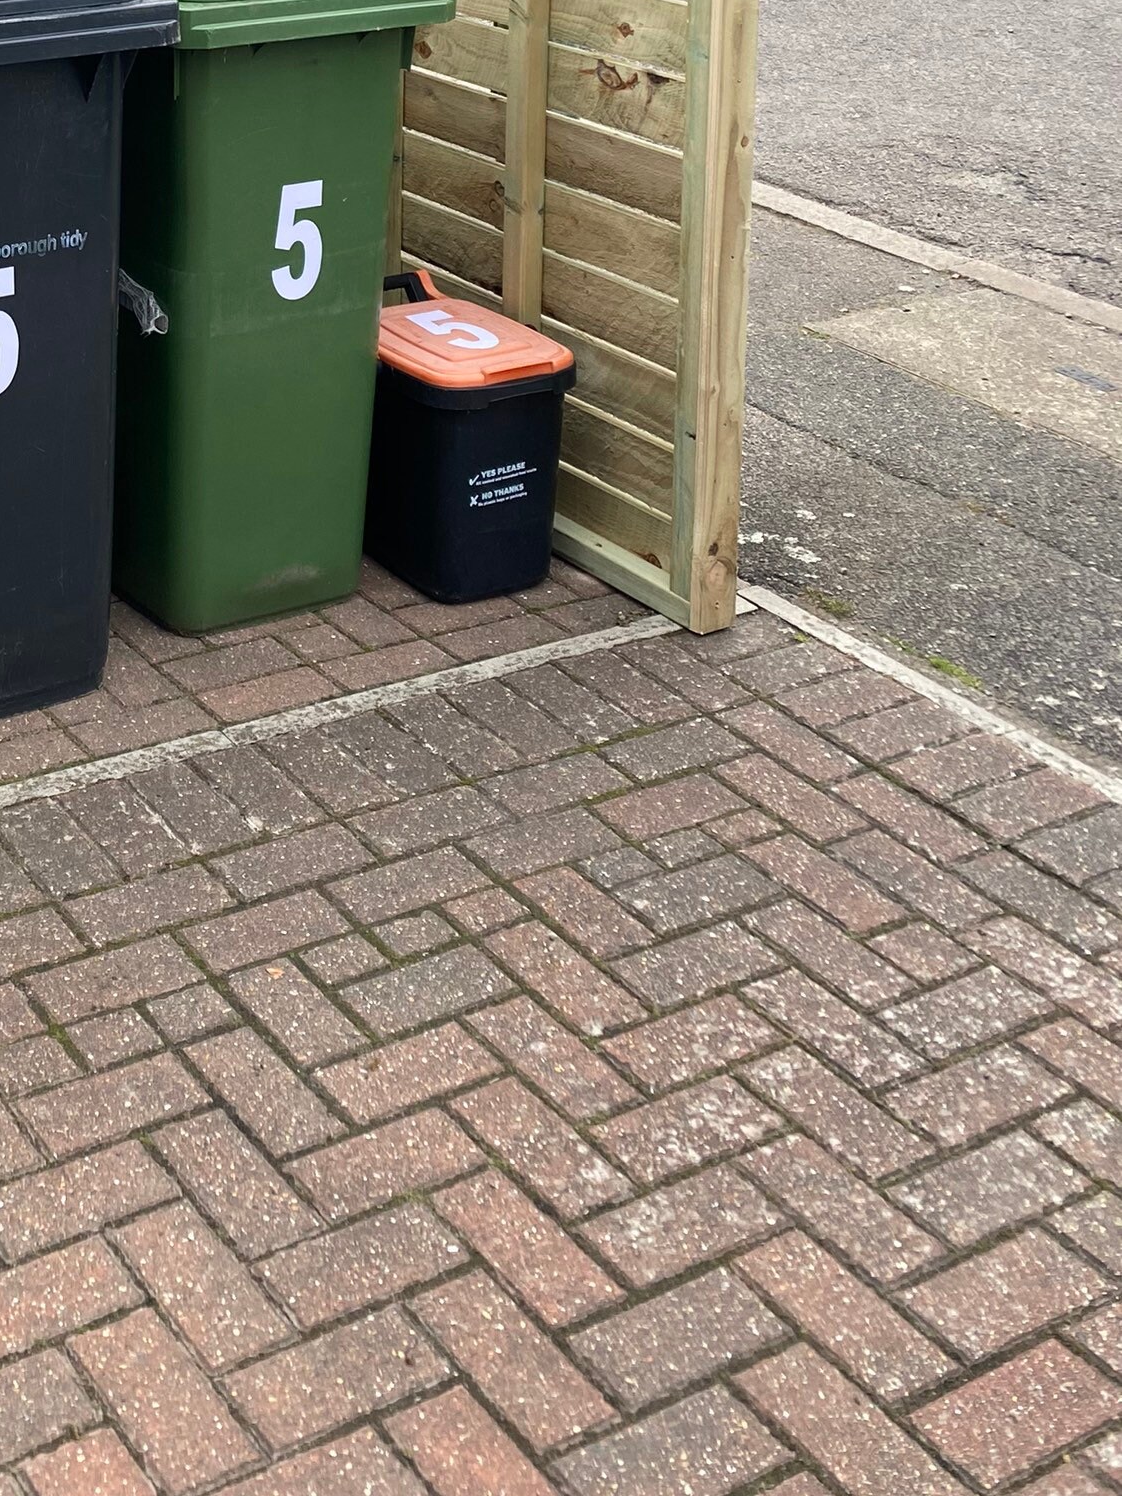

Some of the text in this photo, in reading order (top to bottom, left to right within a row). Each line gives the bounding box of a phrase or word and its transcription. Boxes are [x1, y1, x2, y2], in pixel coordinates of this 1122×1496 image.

[60, 229, 88, 250] tidy
[271, 179, 323, 300] 5
[406, 309, 500, 350] 5
[481, 469, 496, 478] YES
[497, 462, 526, 475] PLEASE
[482, 483, 524, 500] NO THANKS
